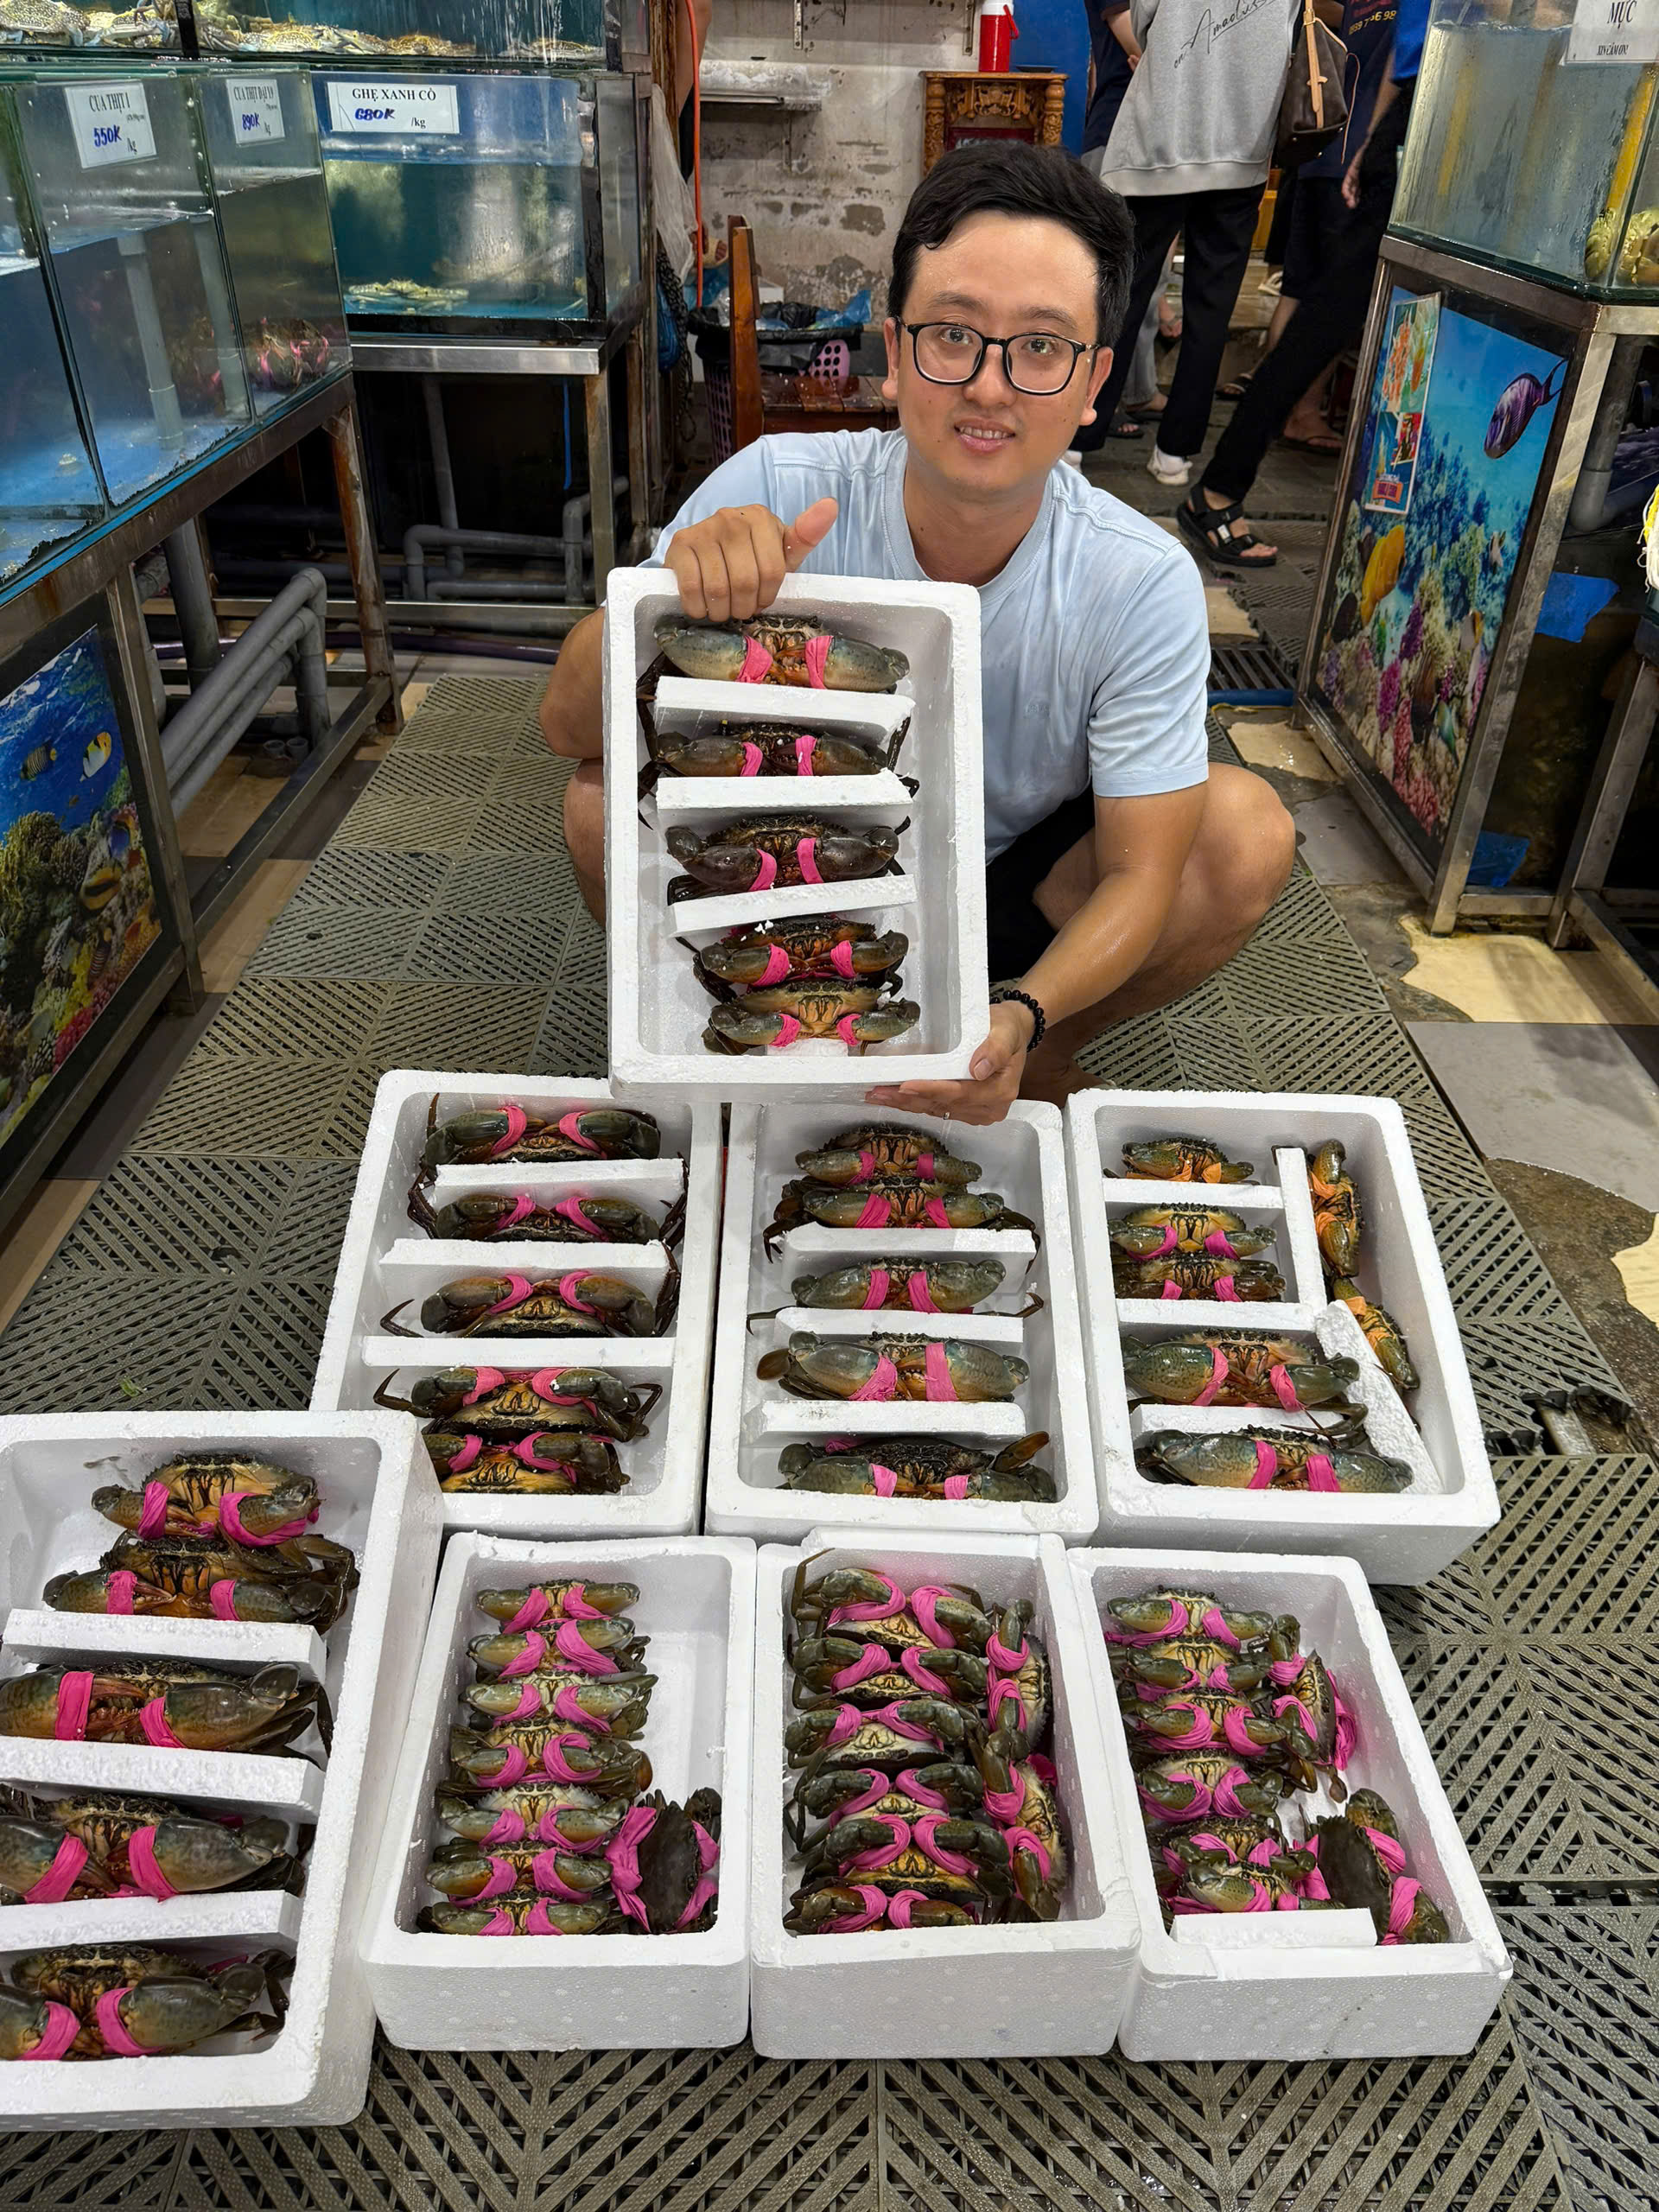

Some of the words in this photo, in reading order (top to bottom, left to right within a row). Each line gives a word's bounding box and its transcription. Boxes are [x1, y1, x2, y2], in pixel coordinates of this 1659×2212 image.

[89, 94, 107, 112] CUA
[352, 88, 378, 102] GHẸ
[381, 90, 416, 100] XANH
[410, 117, 427, 130] /kg
[93, 124, 123, 148] 550K
